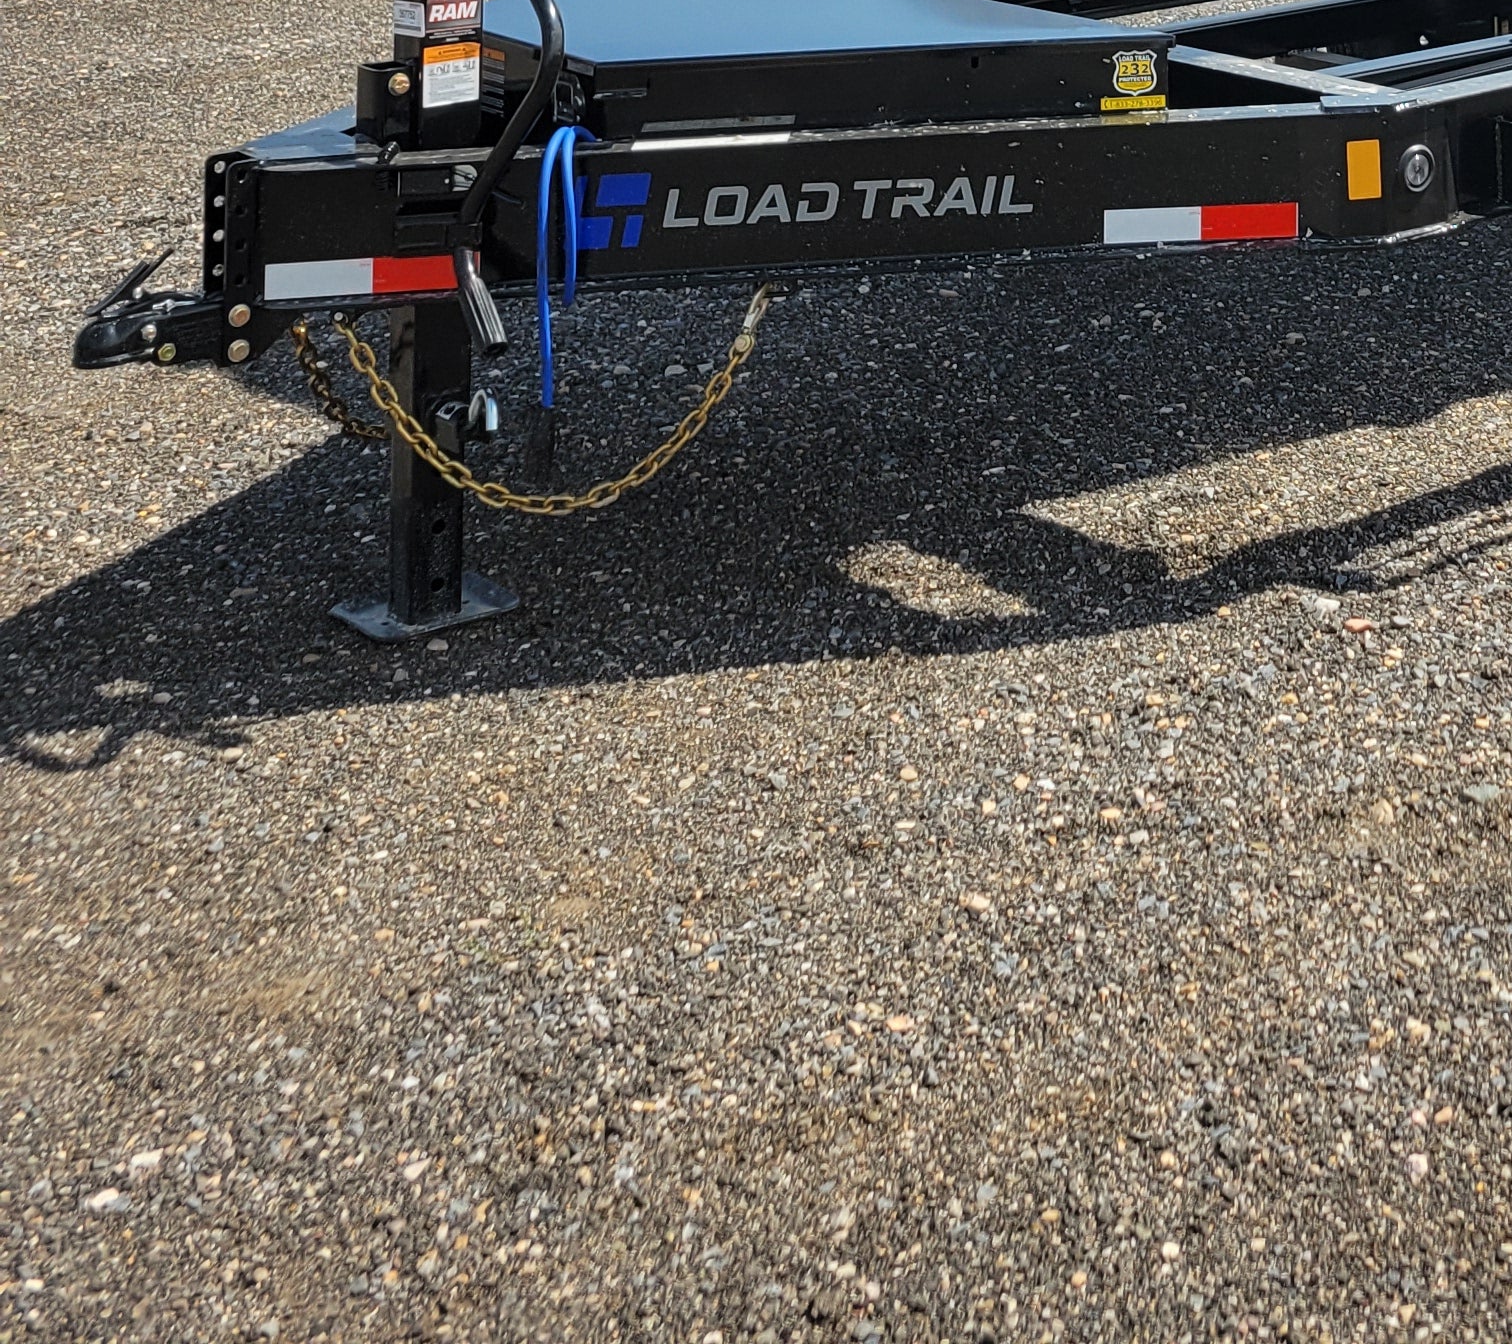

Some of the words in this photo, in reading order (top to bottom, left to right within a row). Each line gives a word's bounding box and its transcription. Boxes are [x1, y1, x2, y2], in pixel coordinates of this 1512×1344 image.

[429, 0, 478, 23] RAM
[1121, 63, 1149, 75] 232
[662, 183, 840, 228] LOAD
[853, 175, 1035, 219] TRAIL
